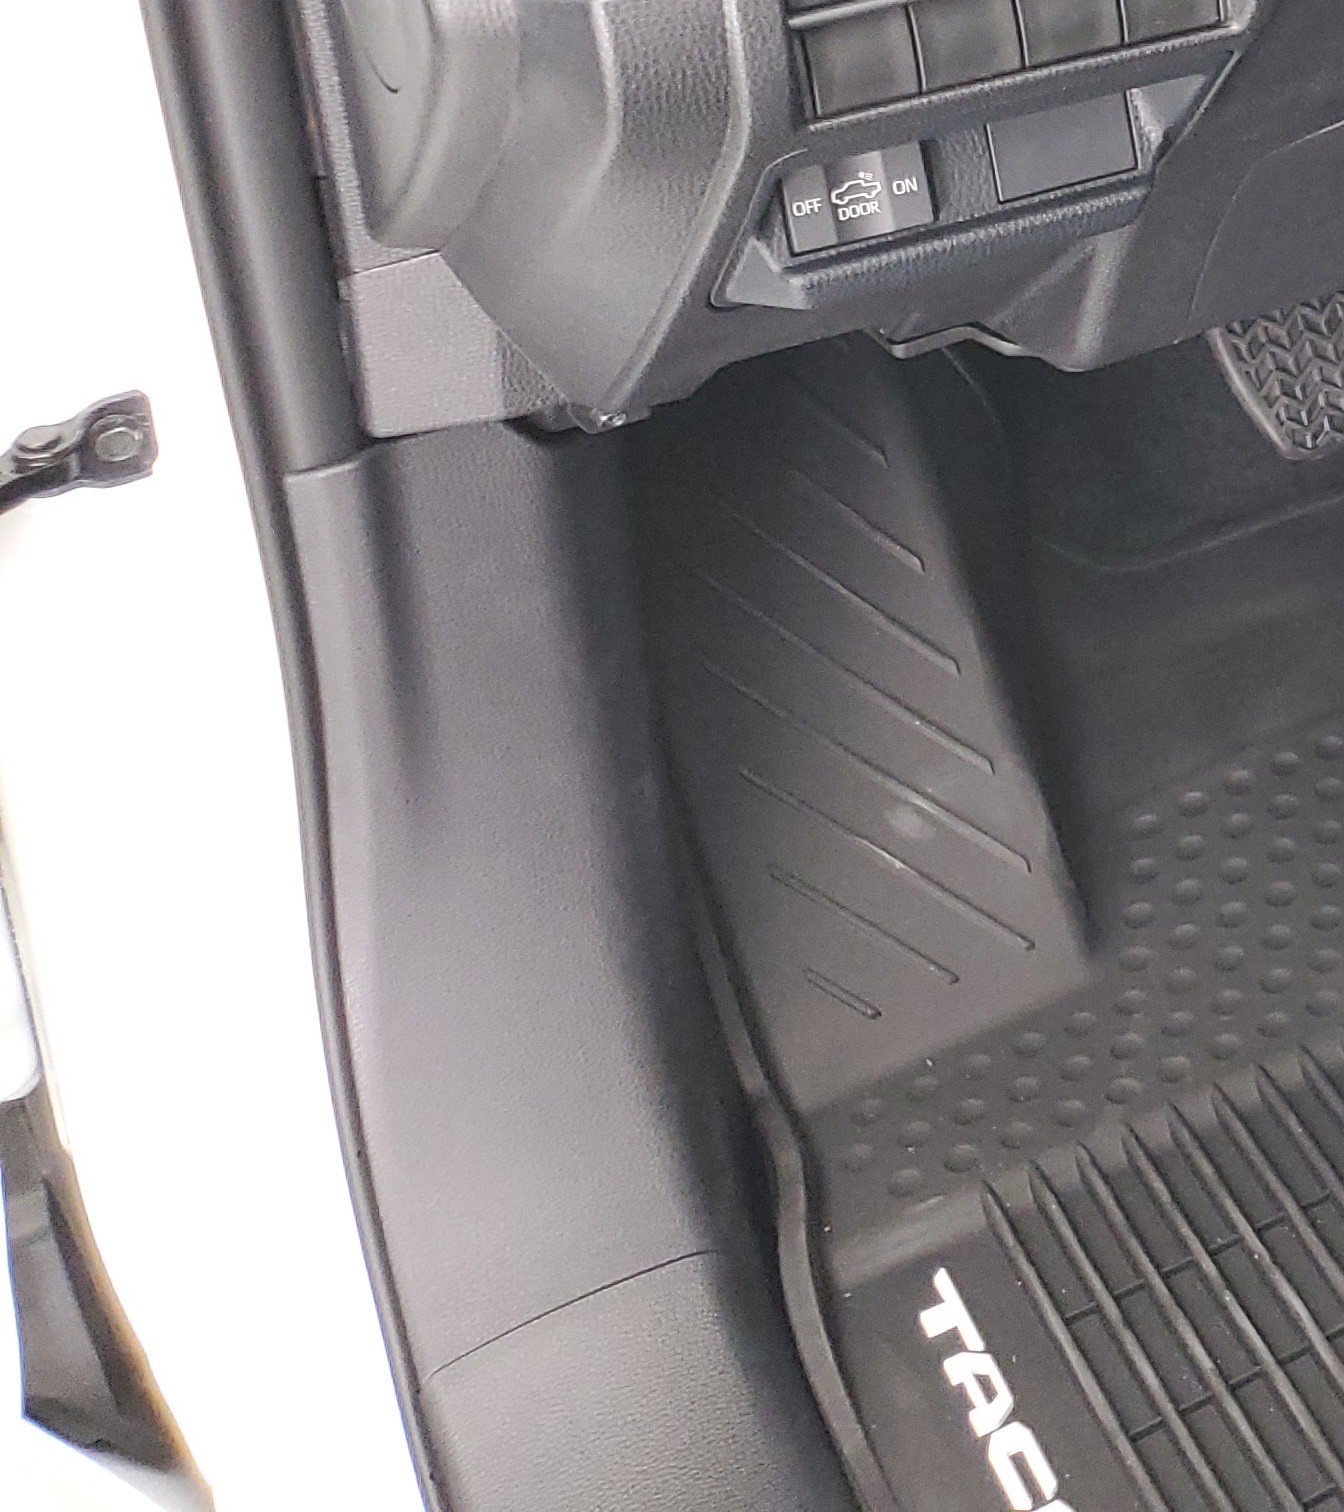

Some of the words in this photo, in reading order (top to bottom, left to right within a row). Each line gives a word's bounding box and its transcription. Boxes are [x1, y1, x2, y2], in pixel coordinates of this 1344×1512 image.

[892, 175, 919, 196] ON
[792, 196, 822, 218] OFF
[837, 200, 882, 222] DOOR
[919, 1267, 1076, 1512] TAC
